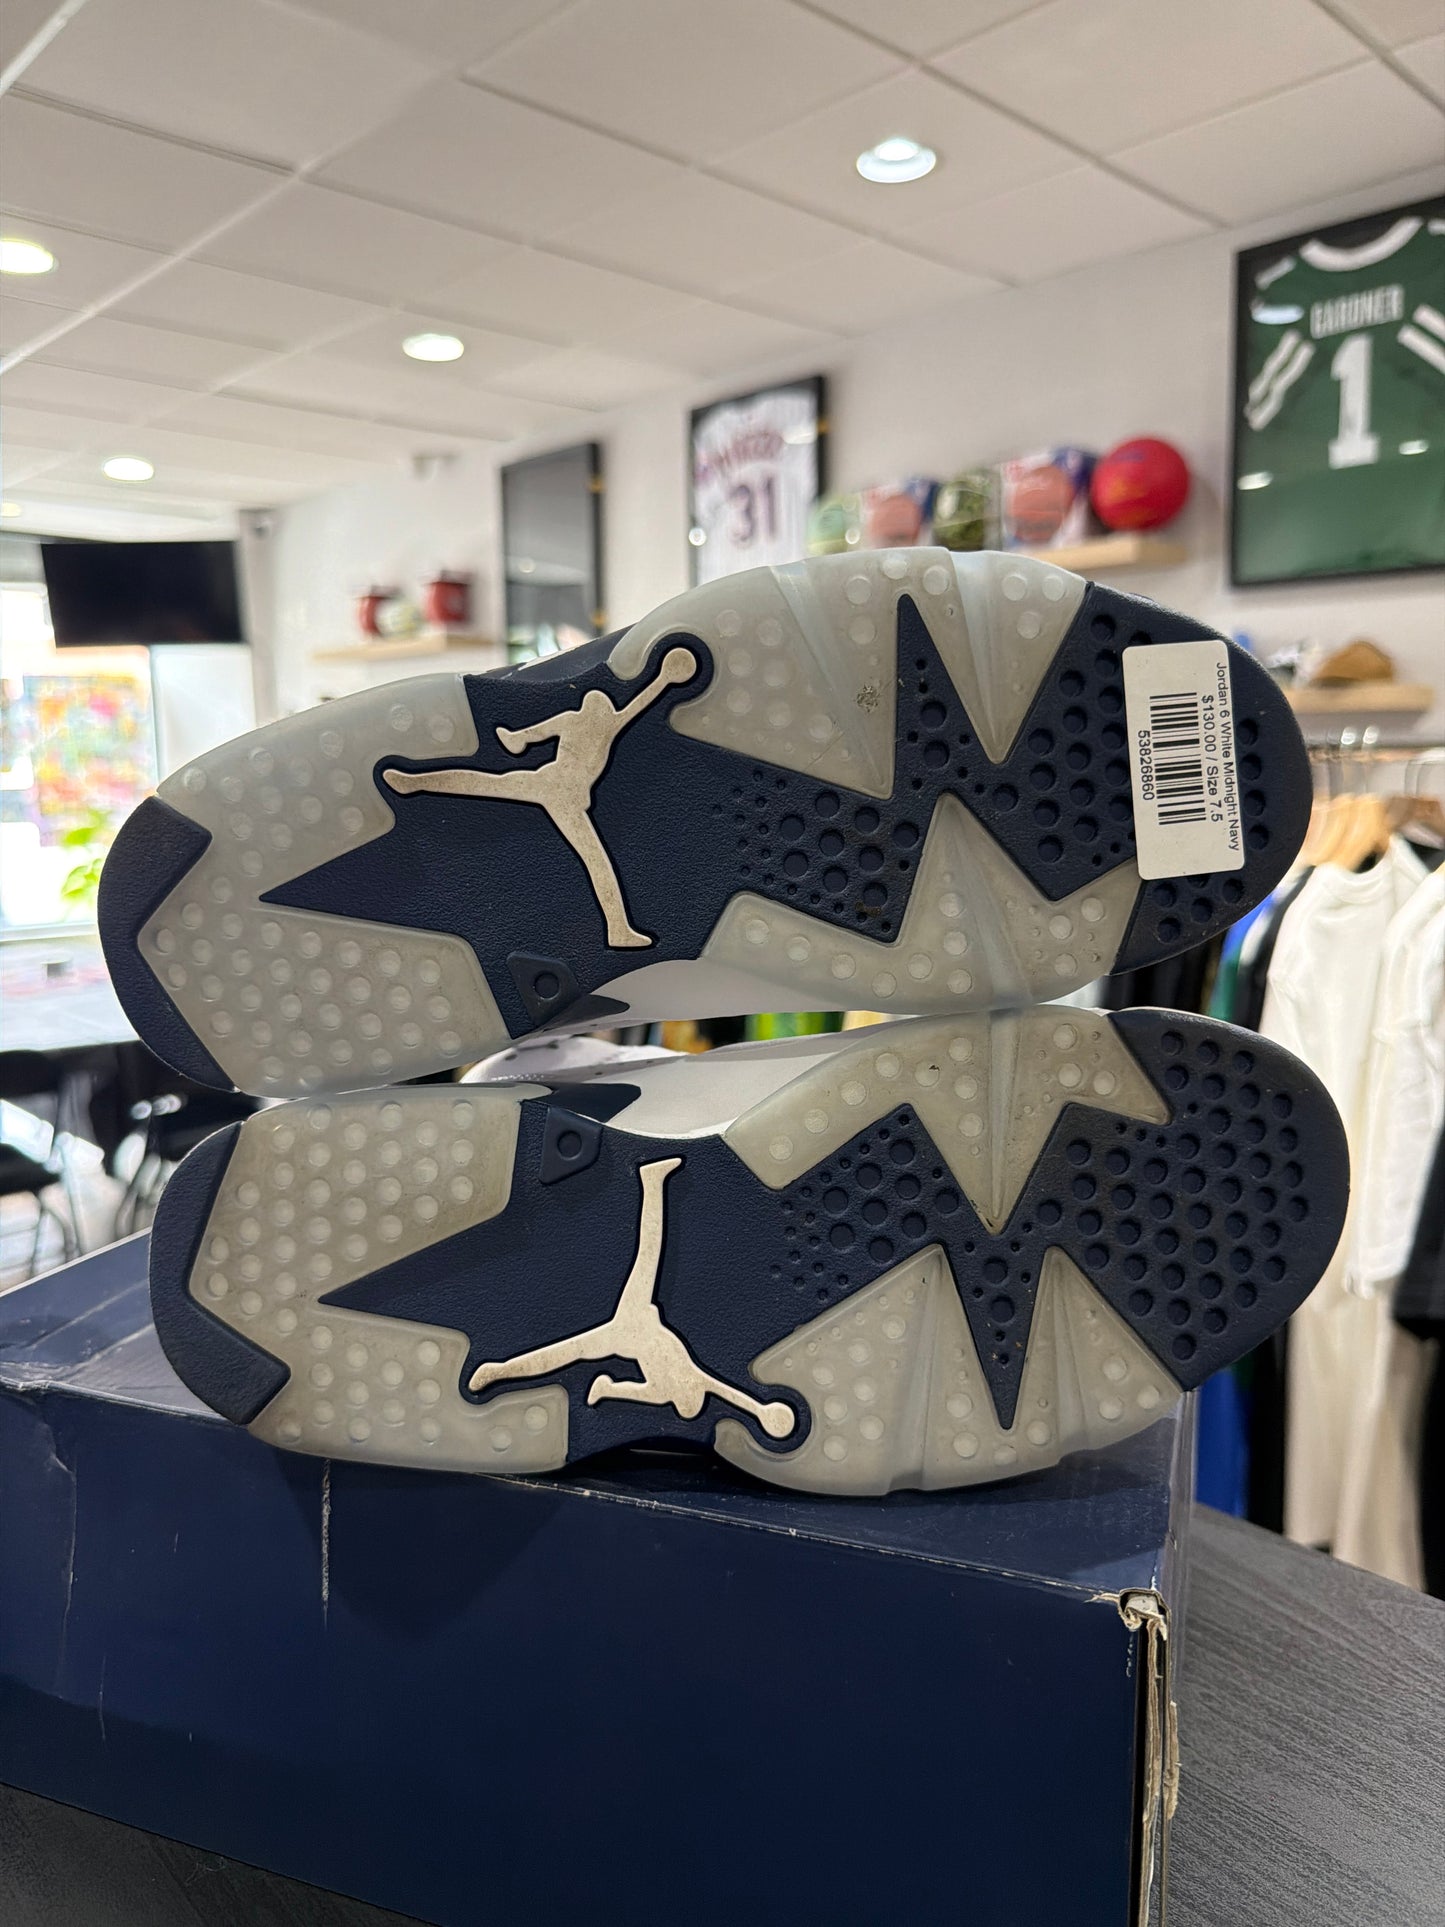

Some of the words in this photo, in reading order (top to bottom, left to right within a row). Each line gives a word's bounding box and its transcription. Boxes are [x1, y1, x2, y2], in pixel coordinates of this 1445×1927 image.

[1329, 333, 1379, 469] 1
[728, 474, 778, 549] 31
[1216, 663, 1228, 706] Jordan
[1202, 695, 1216, 752] $130.00
[1220, 710, 1230, 718] 6
[1220, 721, 1232, 759] White
[1138, 730, 1155, 800] 53826860
[1206, 766, 1218, 796] Size
[1223, 762, 1236, 816] Midnight
[1210, 800, 1223, 822] 7.5
[1228, 818, 1240, 852] Navy
